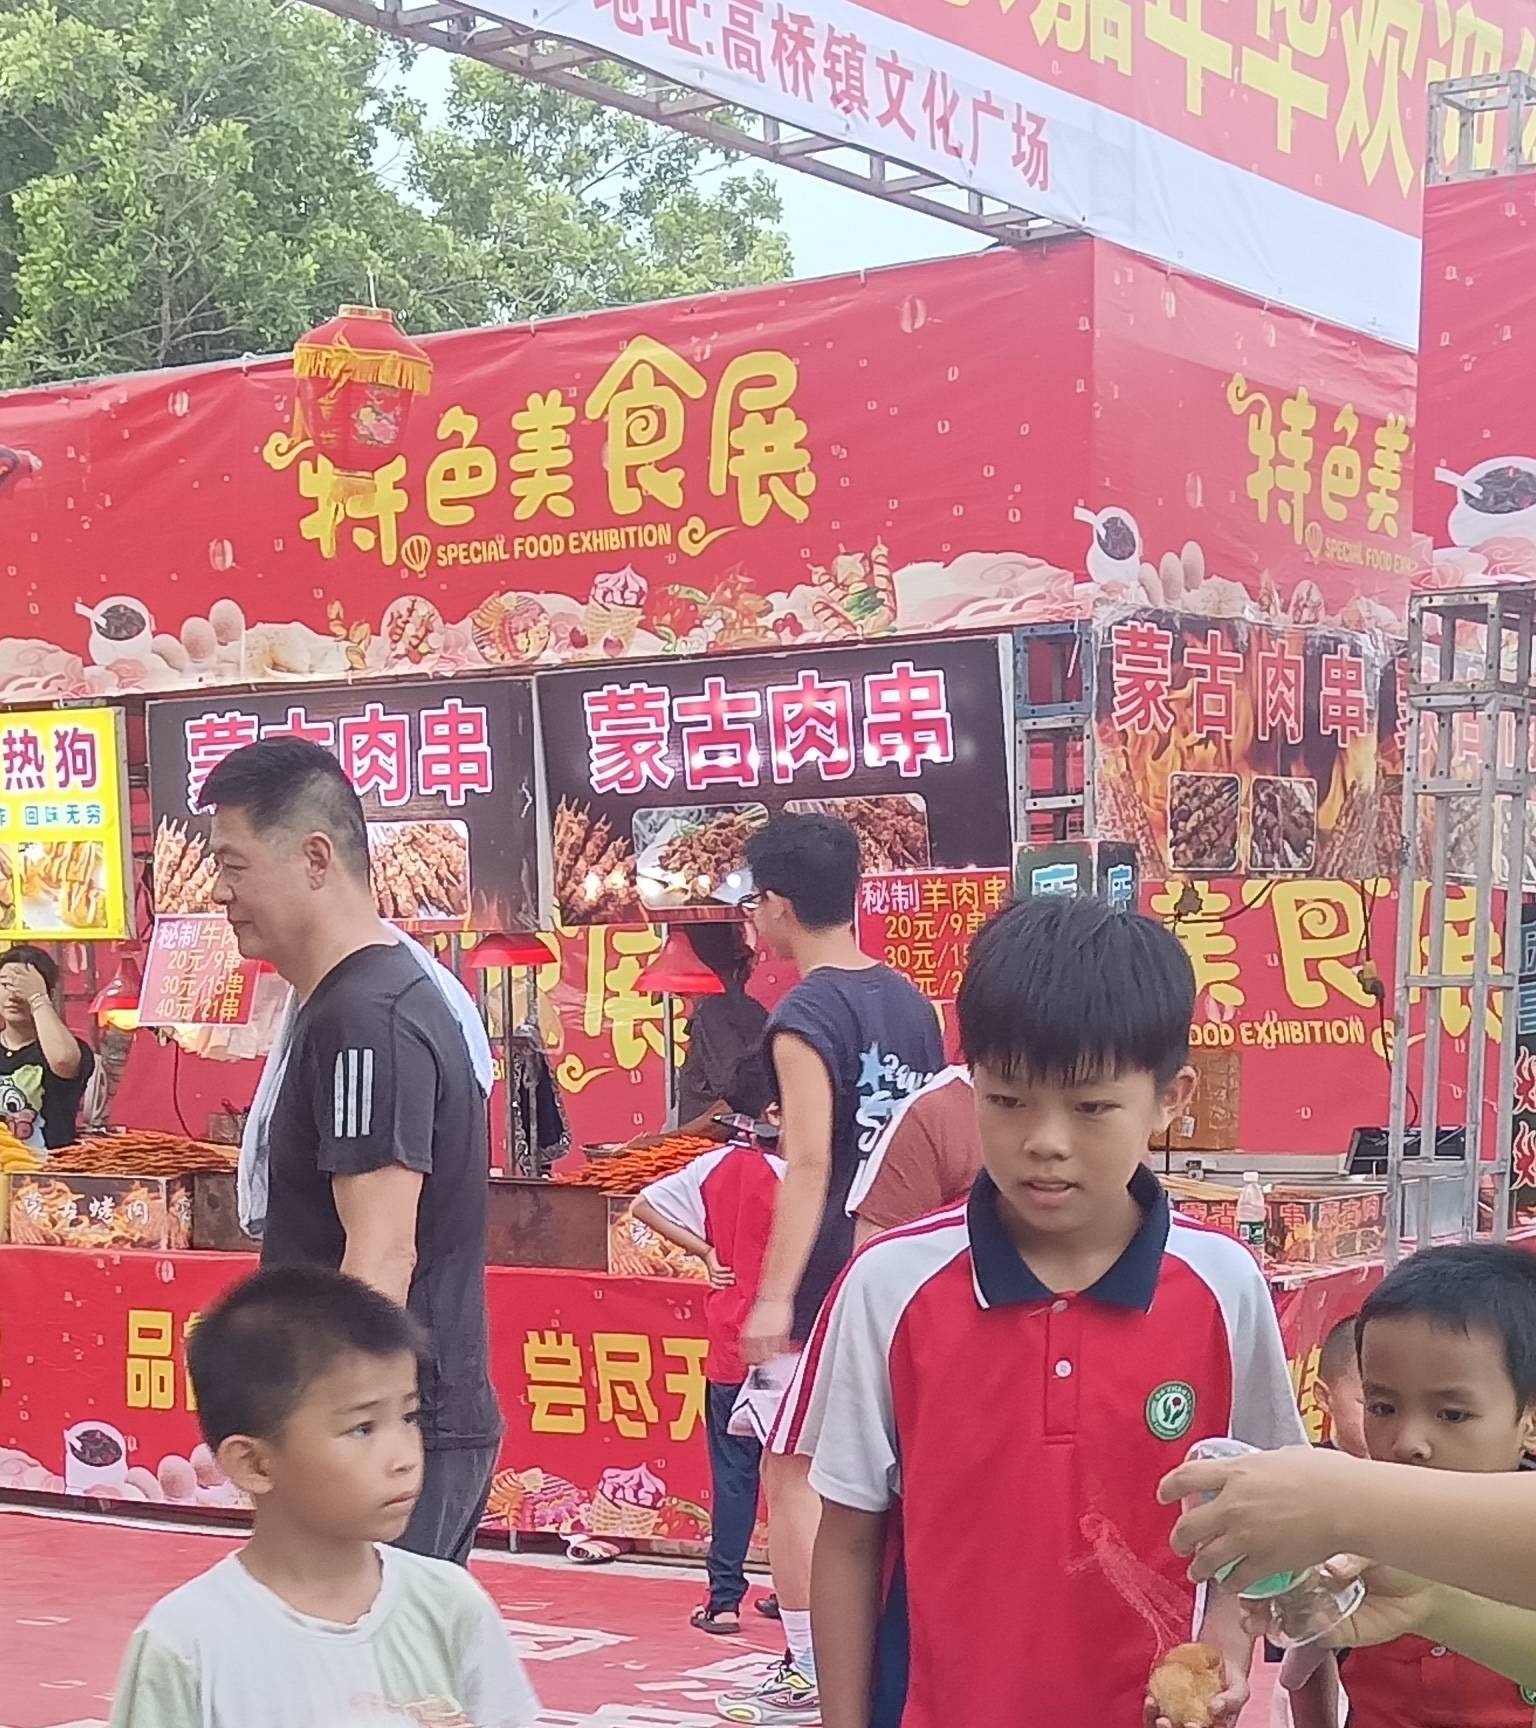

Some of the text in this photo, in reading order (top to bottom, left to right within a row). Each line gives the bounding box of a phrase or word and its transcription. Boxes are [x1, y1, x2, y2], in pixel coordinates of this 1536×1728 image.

[1228, 372, 1410, 545] 特色美
[437, 524, 672, 568] SPECIAL FOOD EXHIBITION
[586, 660, 956, 796] 蒙古肉串
[1111, 619, 1368, 748] 蒙古肉串
[185, 700, 493, 814] 蒙肉串
[1240, 1016, 1365, 1046] EXHIBITION
